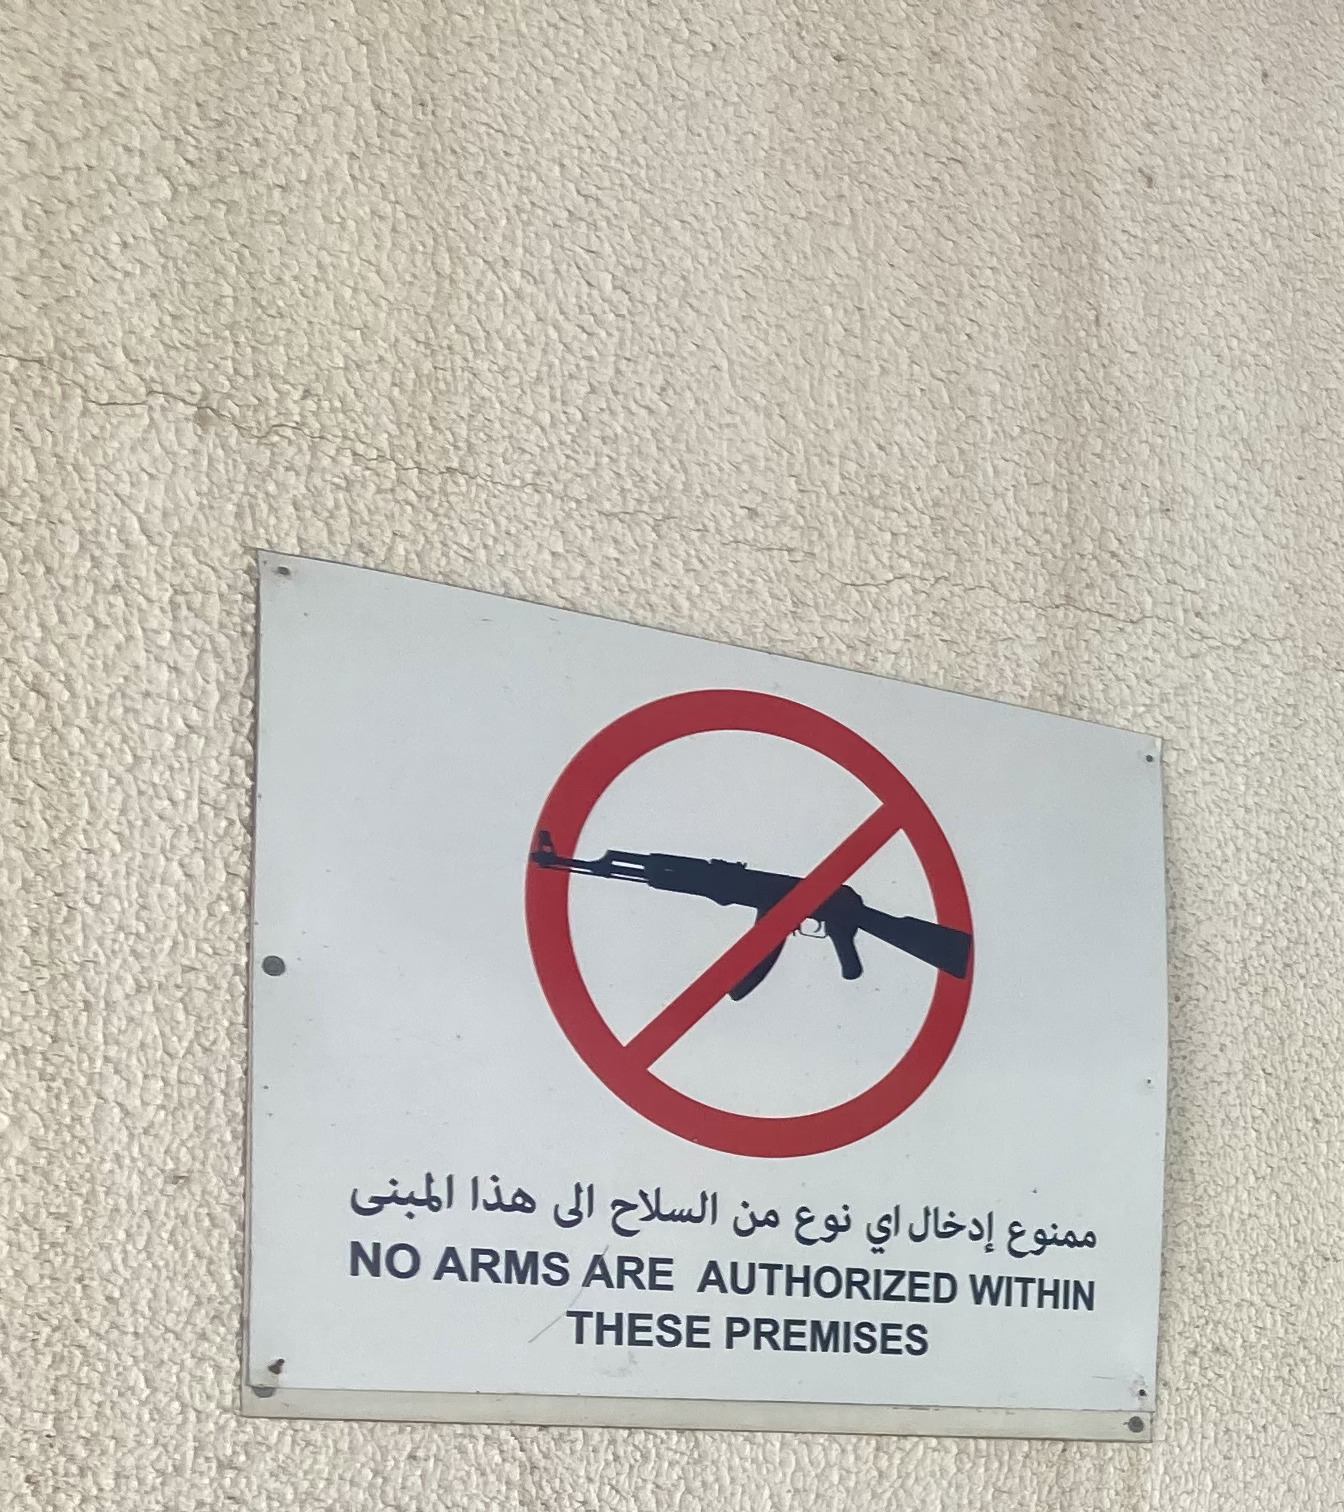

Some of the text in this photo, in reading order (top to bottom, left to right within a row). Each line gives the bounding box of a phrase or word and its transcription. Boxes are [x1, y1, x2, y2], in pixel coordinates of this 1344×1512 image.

[350, 1172, 1097, 1259] ممنوع إدخال اي نوع من السلاح الى هذا المبنى
[350, 1240, 1095, 1311] NO ARMS ARE AUTHORIZED WITHIN
[565, 1310, 929, 1356] THESE PREMISES
